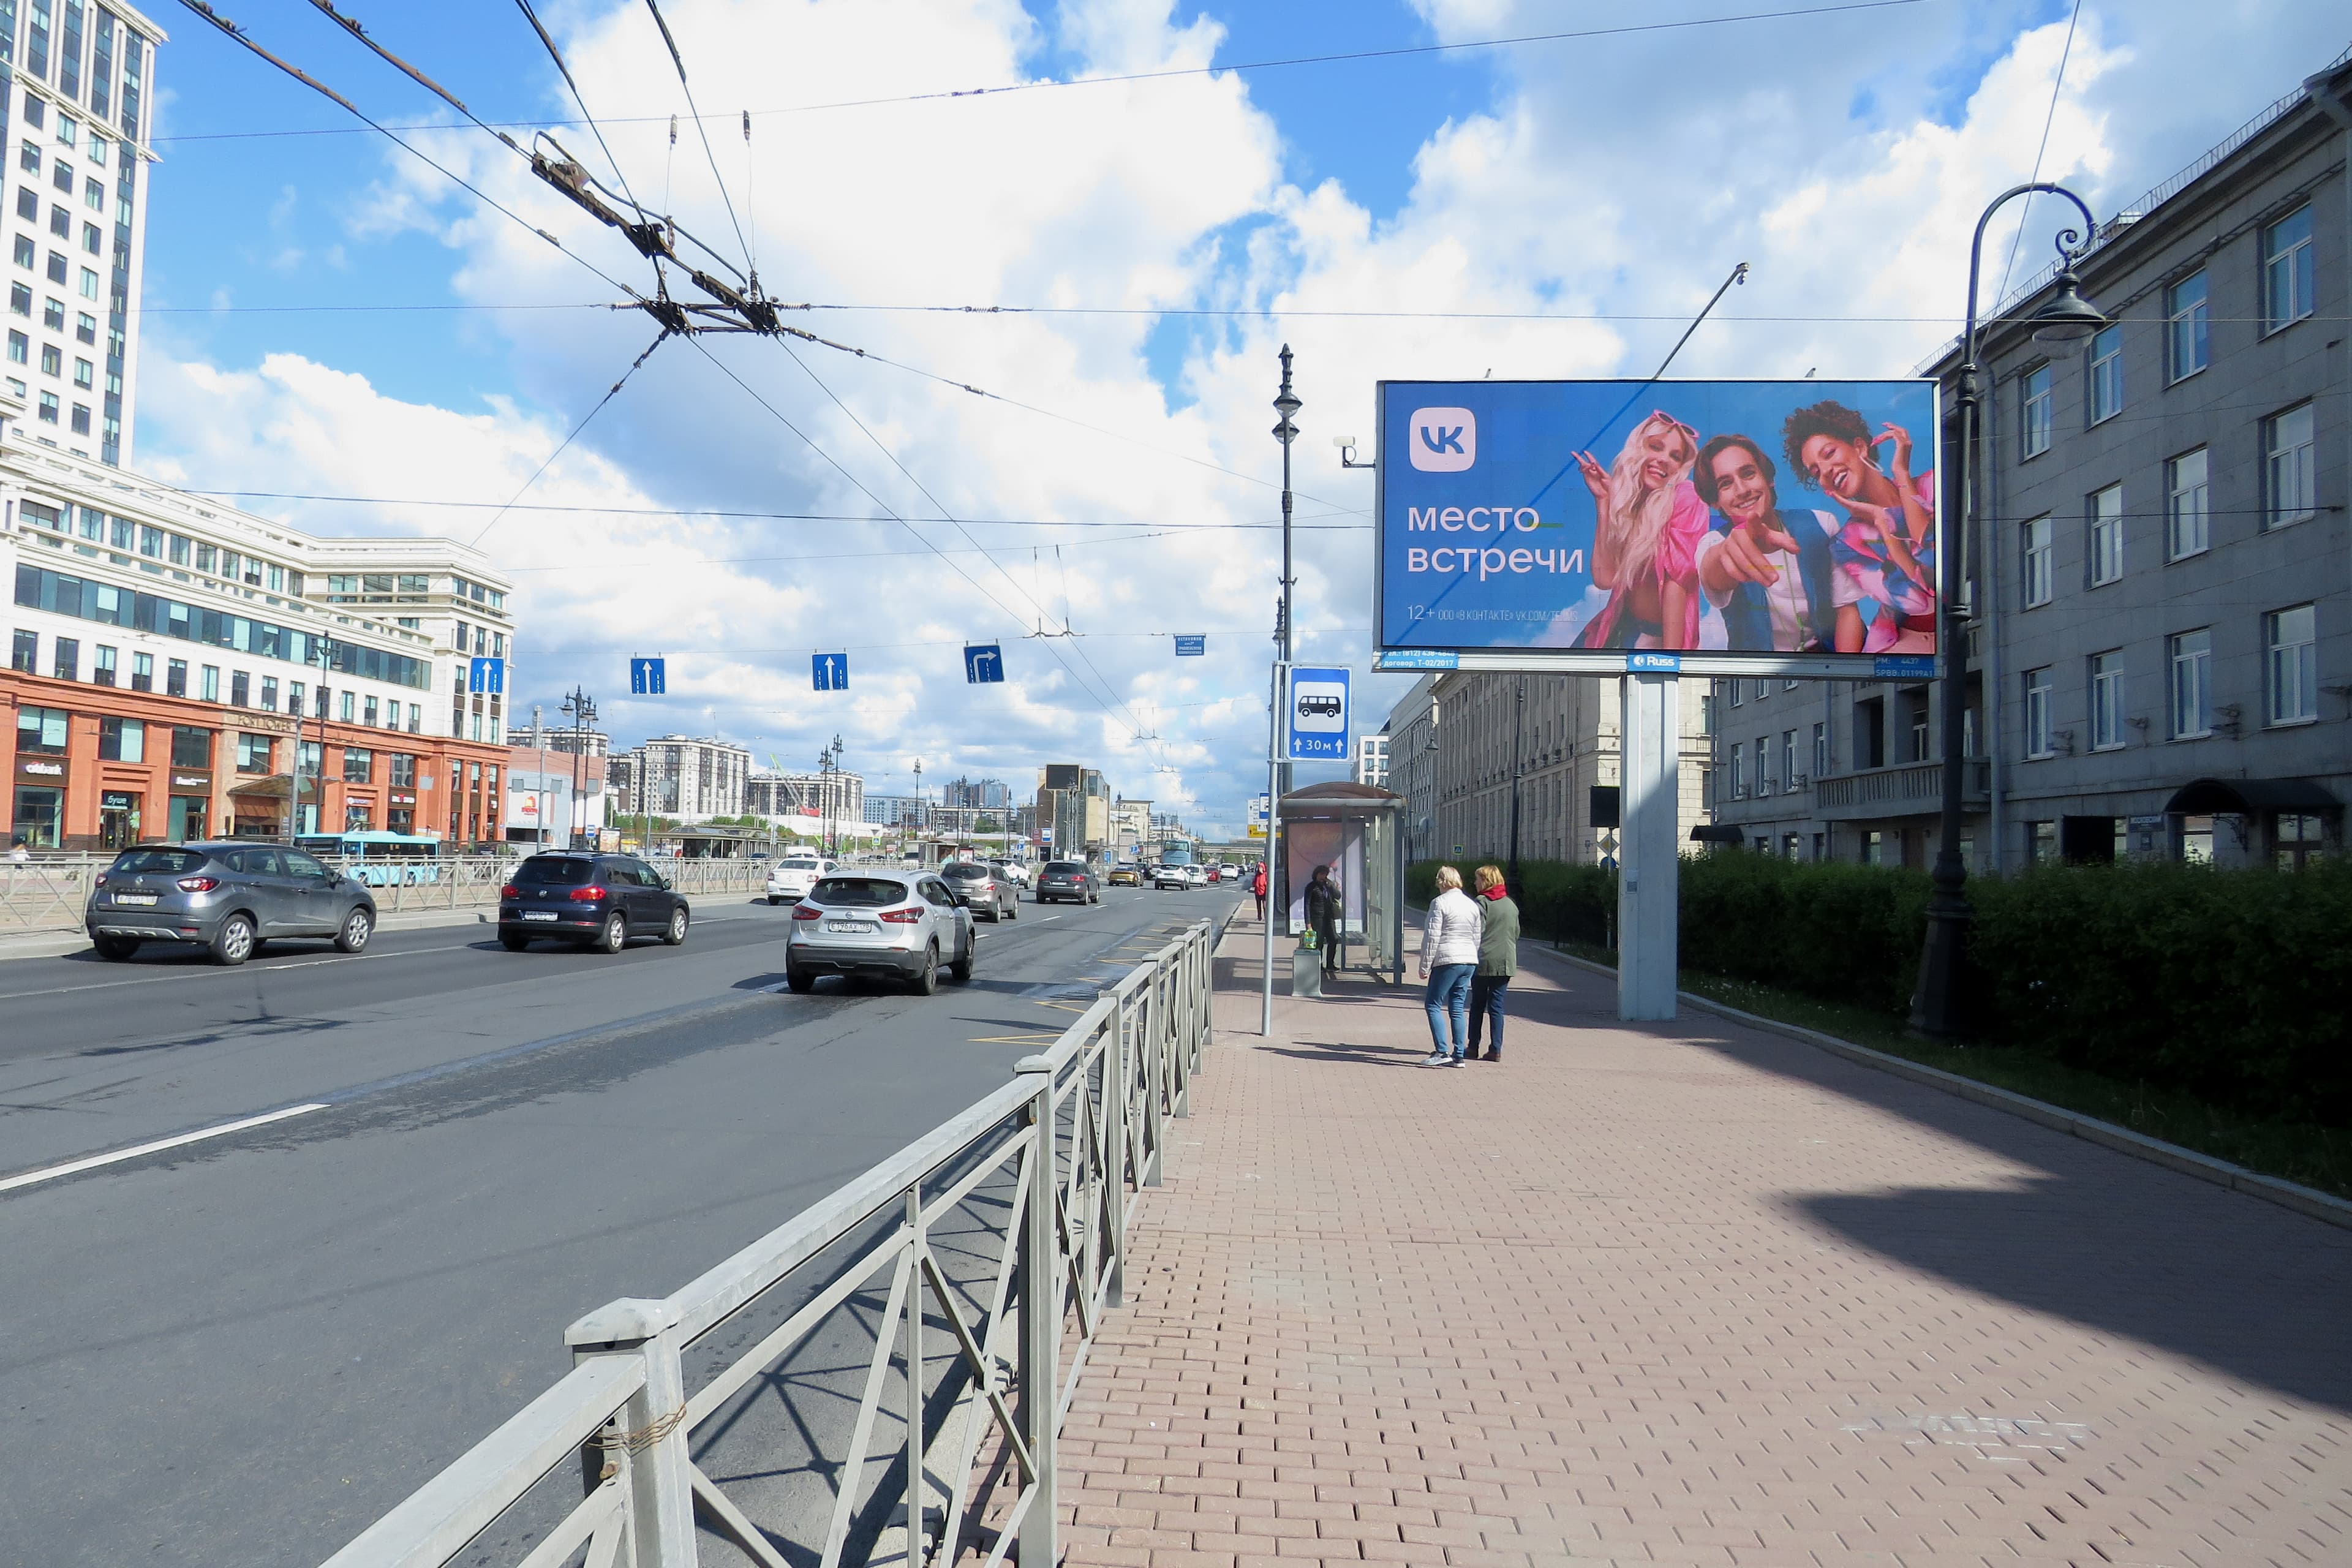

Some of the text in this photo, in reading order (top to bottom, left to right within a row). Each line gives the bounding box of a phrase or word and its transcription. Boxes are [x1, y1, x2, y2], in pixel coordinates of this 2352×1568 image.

[1420, 426, 1464, 454] VK
[1408, 507, 1540, 532] место
[1408, 548, 1583, 582] встречи
[1408, 605, 1435, 620] 12+
[1646, 656, 1675, 666] Russ
